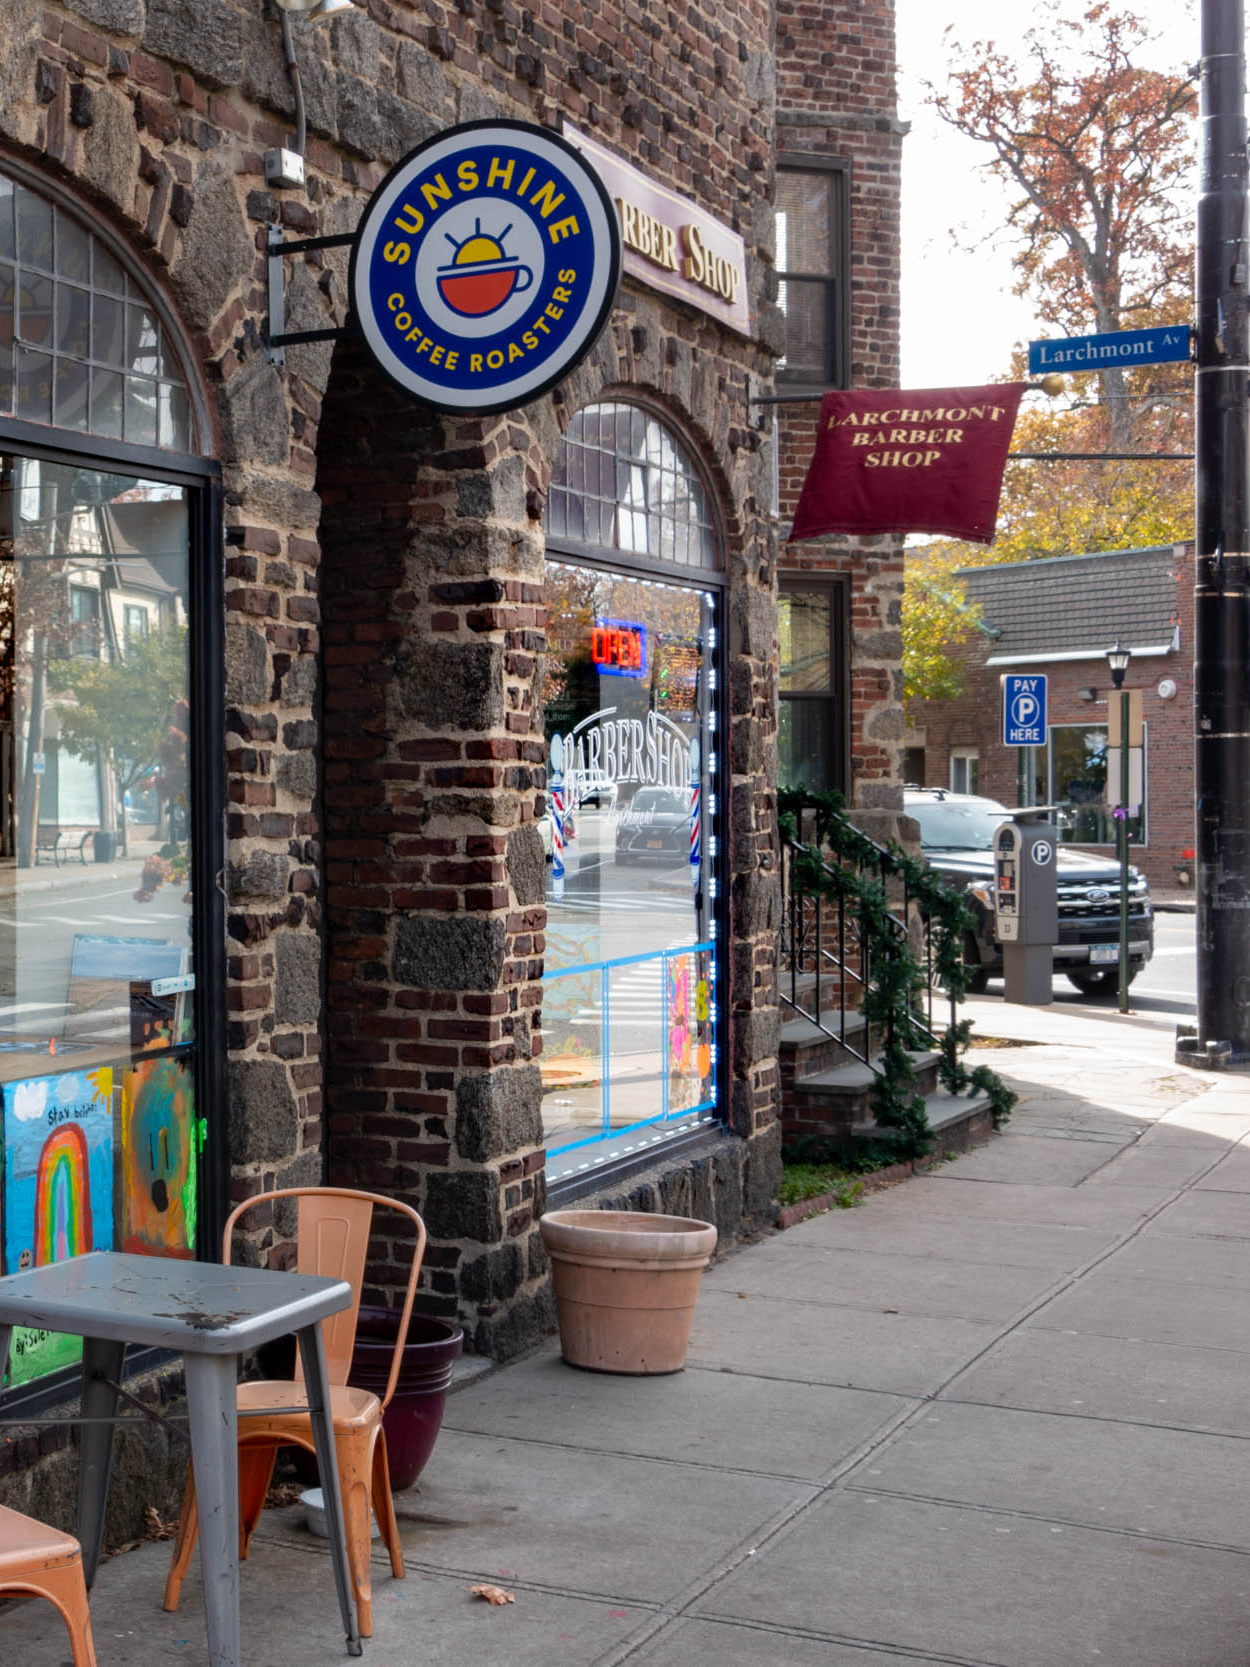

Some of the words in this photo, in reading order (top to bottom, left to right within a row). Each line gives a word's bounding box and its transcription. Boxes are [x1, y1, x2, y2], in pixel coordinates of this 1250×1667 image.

[383, 157, 580, 266] SUNSHINE
[683, 223, 741, 304] SHOP
[387, 292, 459, 371] COFFEE
[470, 268, 576, 373] ROASTERS
[1039, 338, 1154, 365] Larchmont
[1162, 331, 1181, 346] Av
[826, 405, 1006, 431] LARCHMONT
[852, 428, 965, 447] BARBER
[864, 451, 941, 469] SHOP
[592, 627, 642, 667] OPEN
[1013, 680, 1038, 692] PAY
[1018, 698, 1034, 722] P
[1009, 728, 1040, 742] HERE
